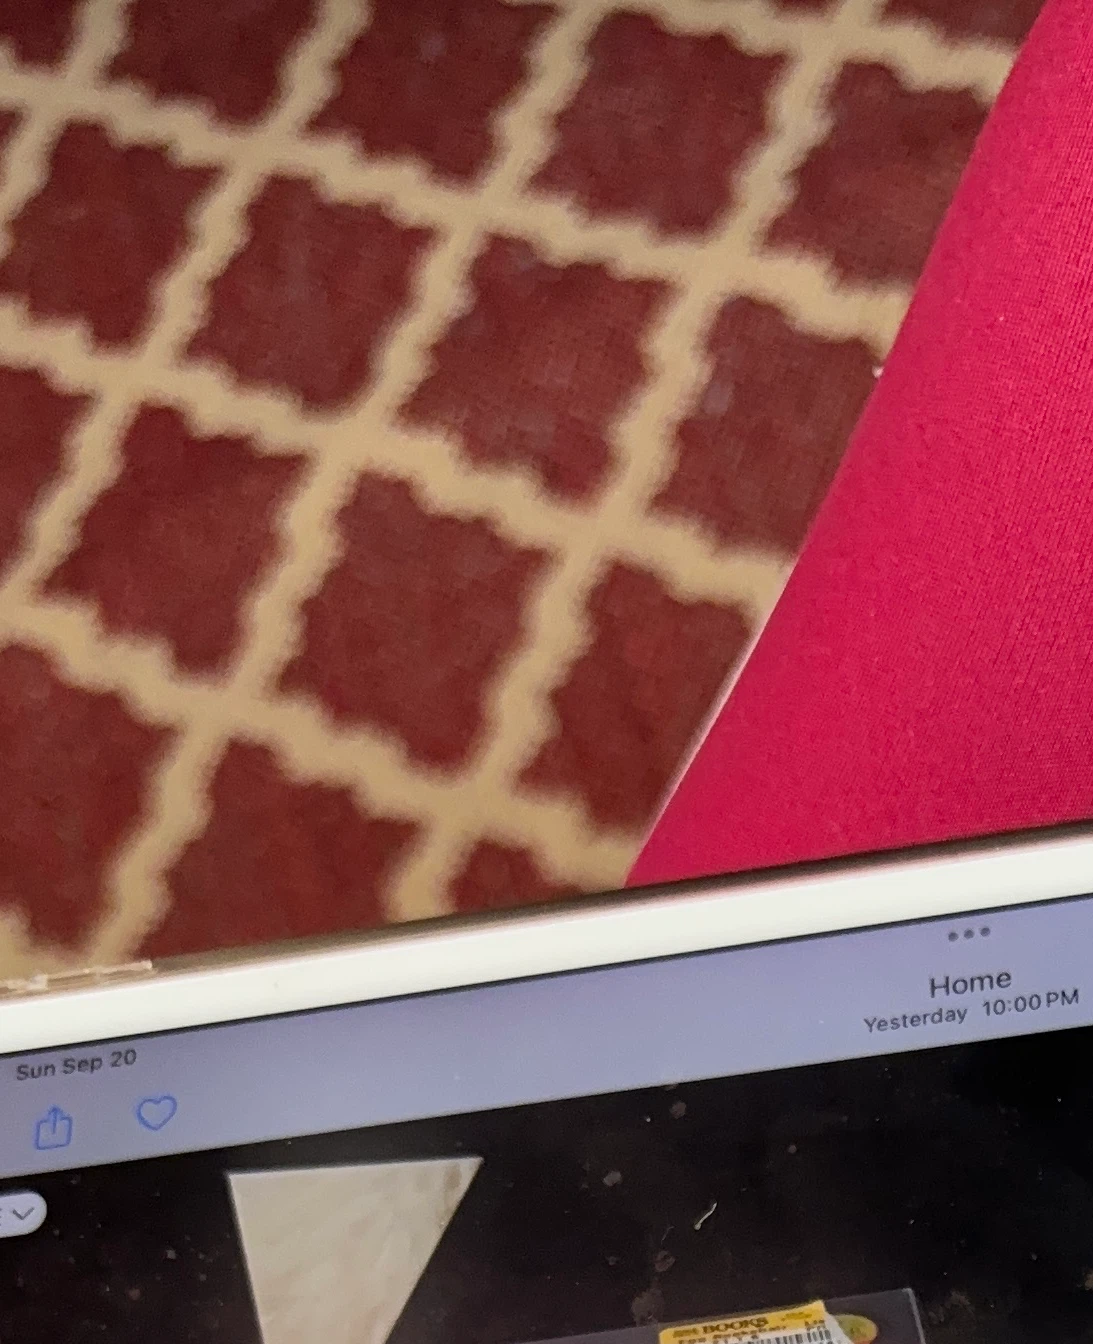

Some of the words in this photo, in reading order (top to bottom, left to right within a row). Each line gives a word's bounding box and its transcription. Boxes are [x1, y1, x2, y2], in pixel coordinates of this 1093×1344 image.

[929, 971, 1012, 998] Home
[864, 1007, 968, 1033] Yesterday
[16, 1064, 56, 1081] Sun
[62, 1056, 103, 1075] Sep
[110, 1049, 137, 1068] 20
